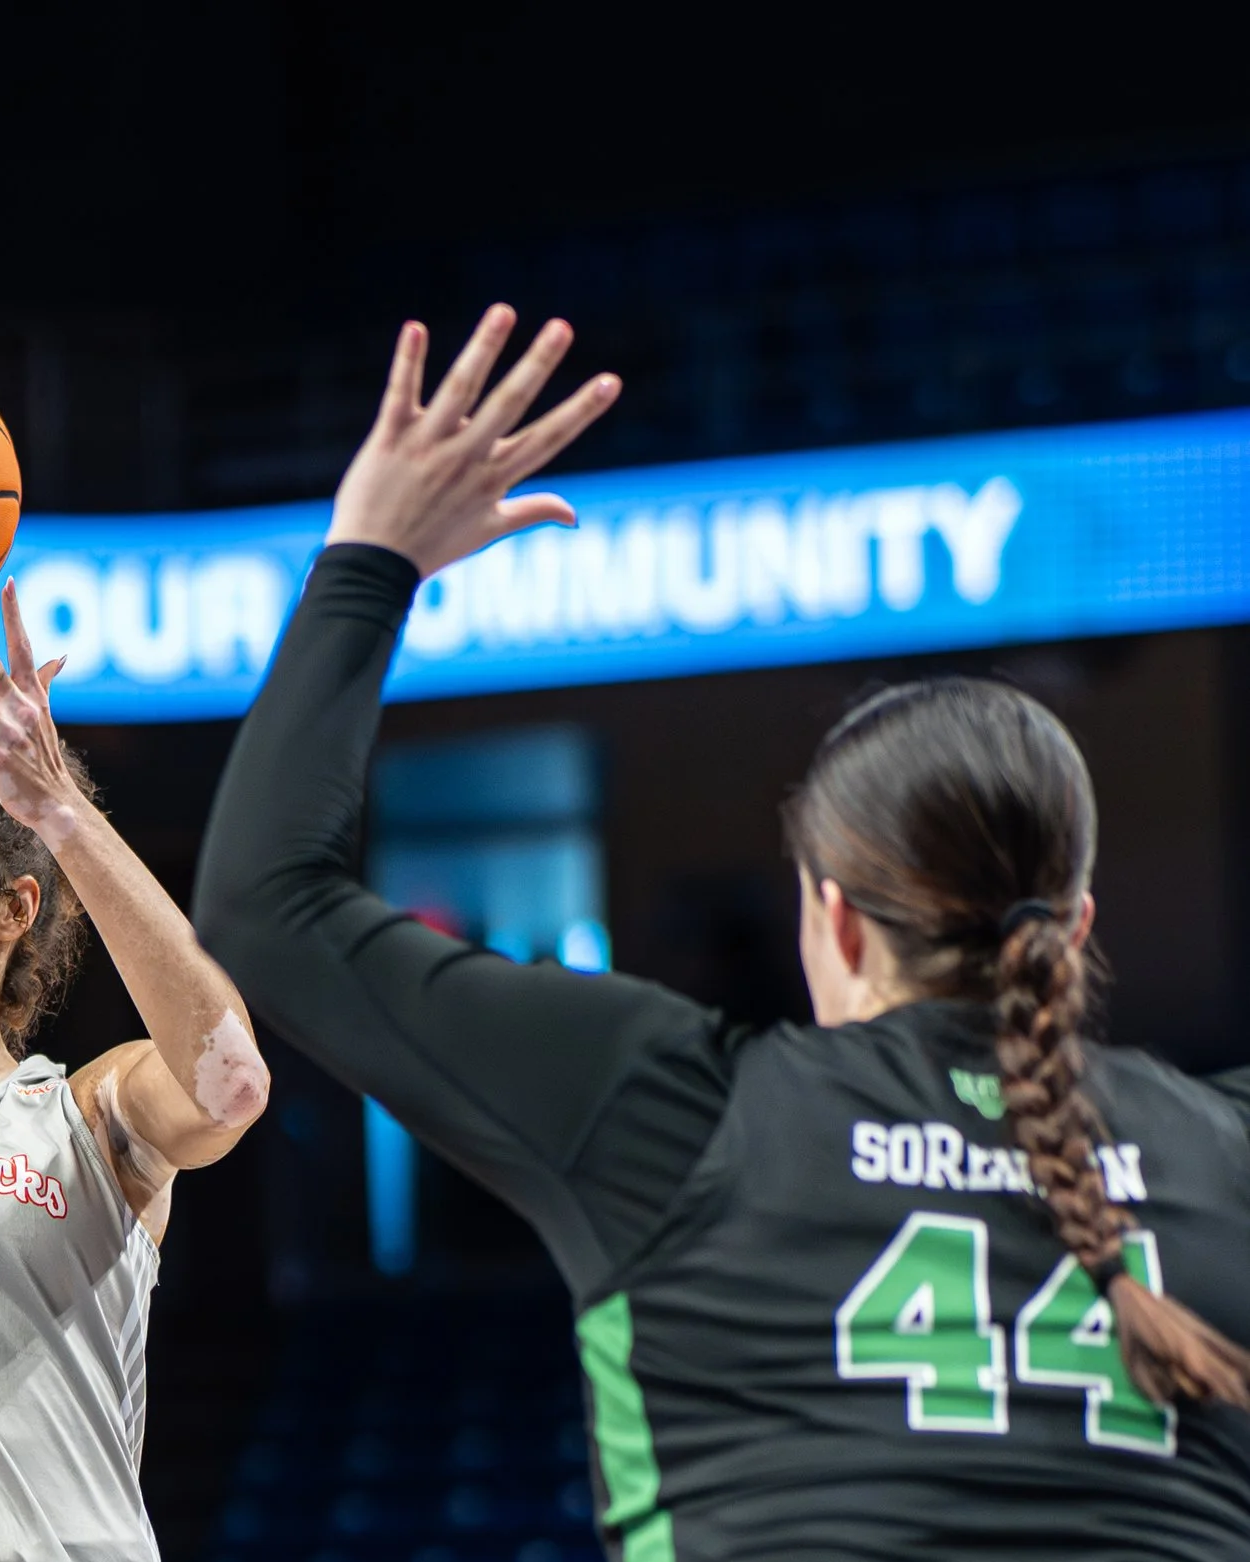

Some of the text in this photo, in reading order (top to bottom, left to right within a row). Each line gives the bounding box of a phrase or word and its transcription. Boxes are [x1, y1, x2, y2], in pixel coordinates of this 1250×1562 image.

[15, 551, 286, 684] OUR
[400, 474, 1024, 660] OMMUNITY
[851, 1119, 1148, 1203] SORENN
[834, 1210, 1179, 1459] 44
